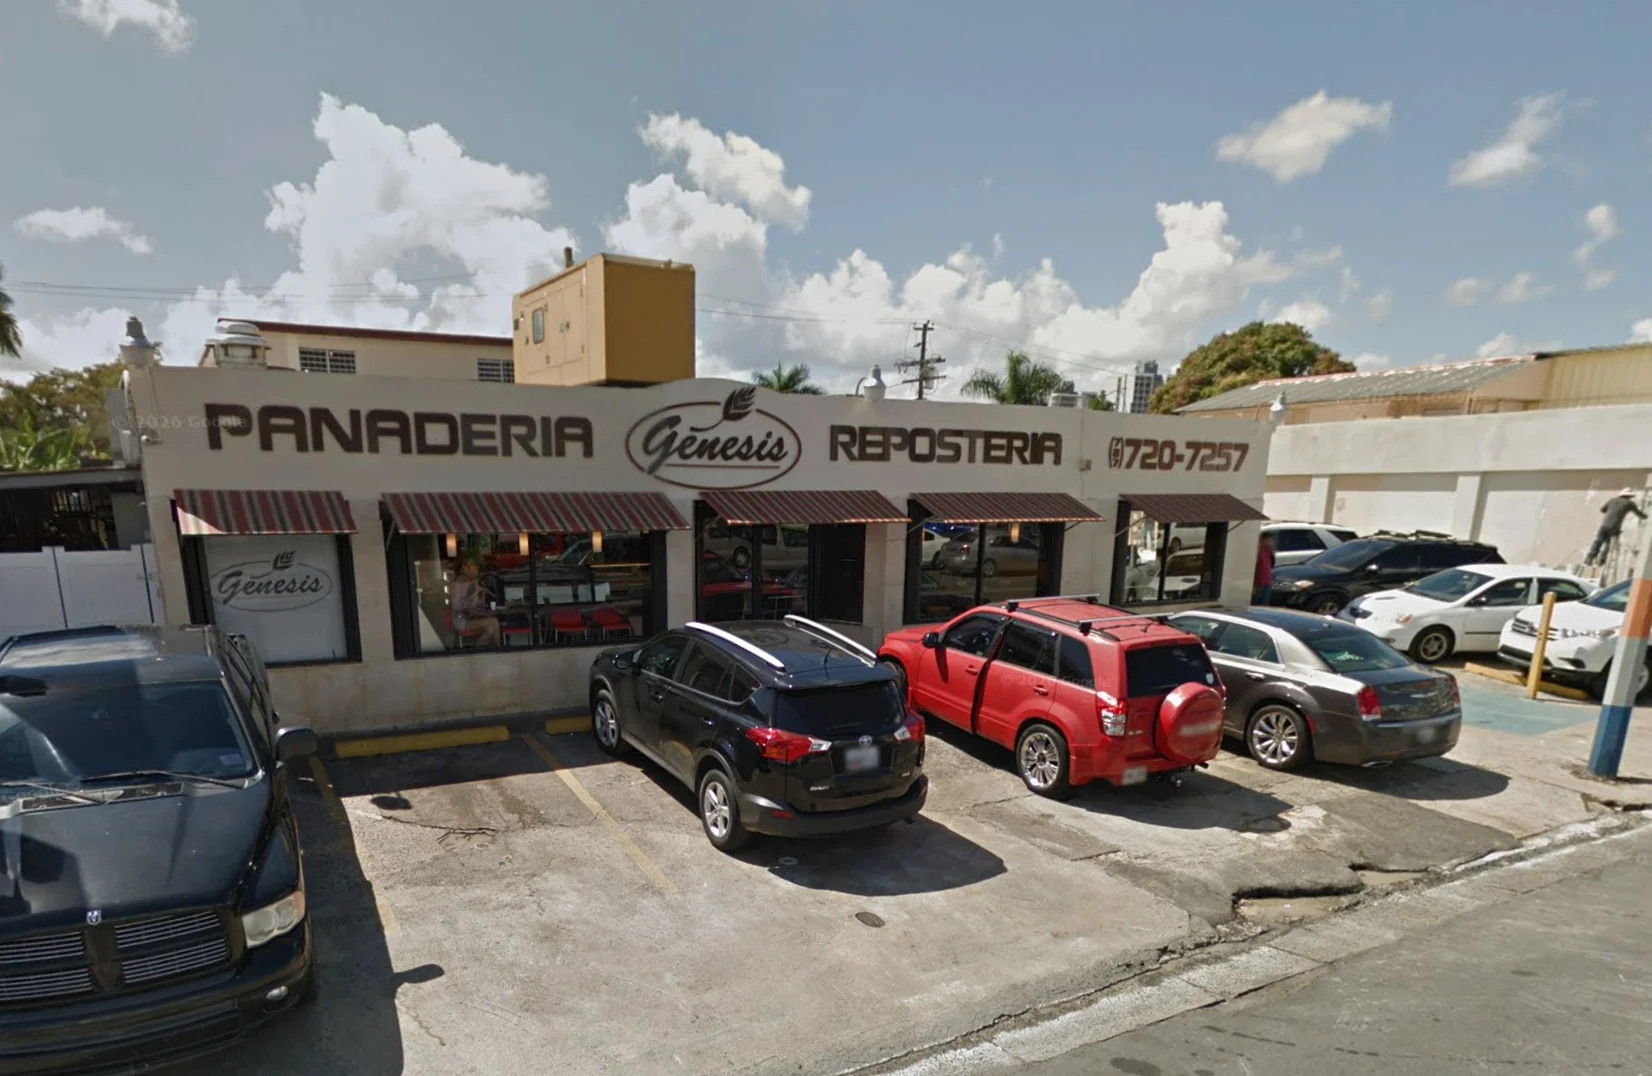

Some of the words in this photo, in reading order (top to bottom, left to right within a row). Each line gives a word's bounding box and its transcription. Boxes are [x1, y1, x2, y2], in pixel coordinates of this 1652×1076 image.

[203, 402, 594, 458] PANADERIA
[642, 414, 789, 475] Genesis
[828, 424, 1063, 466] REPOSTERIA
[217, 569, 323, 606] Genesis
